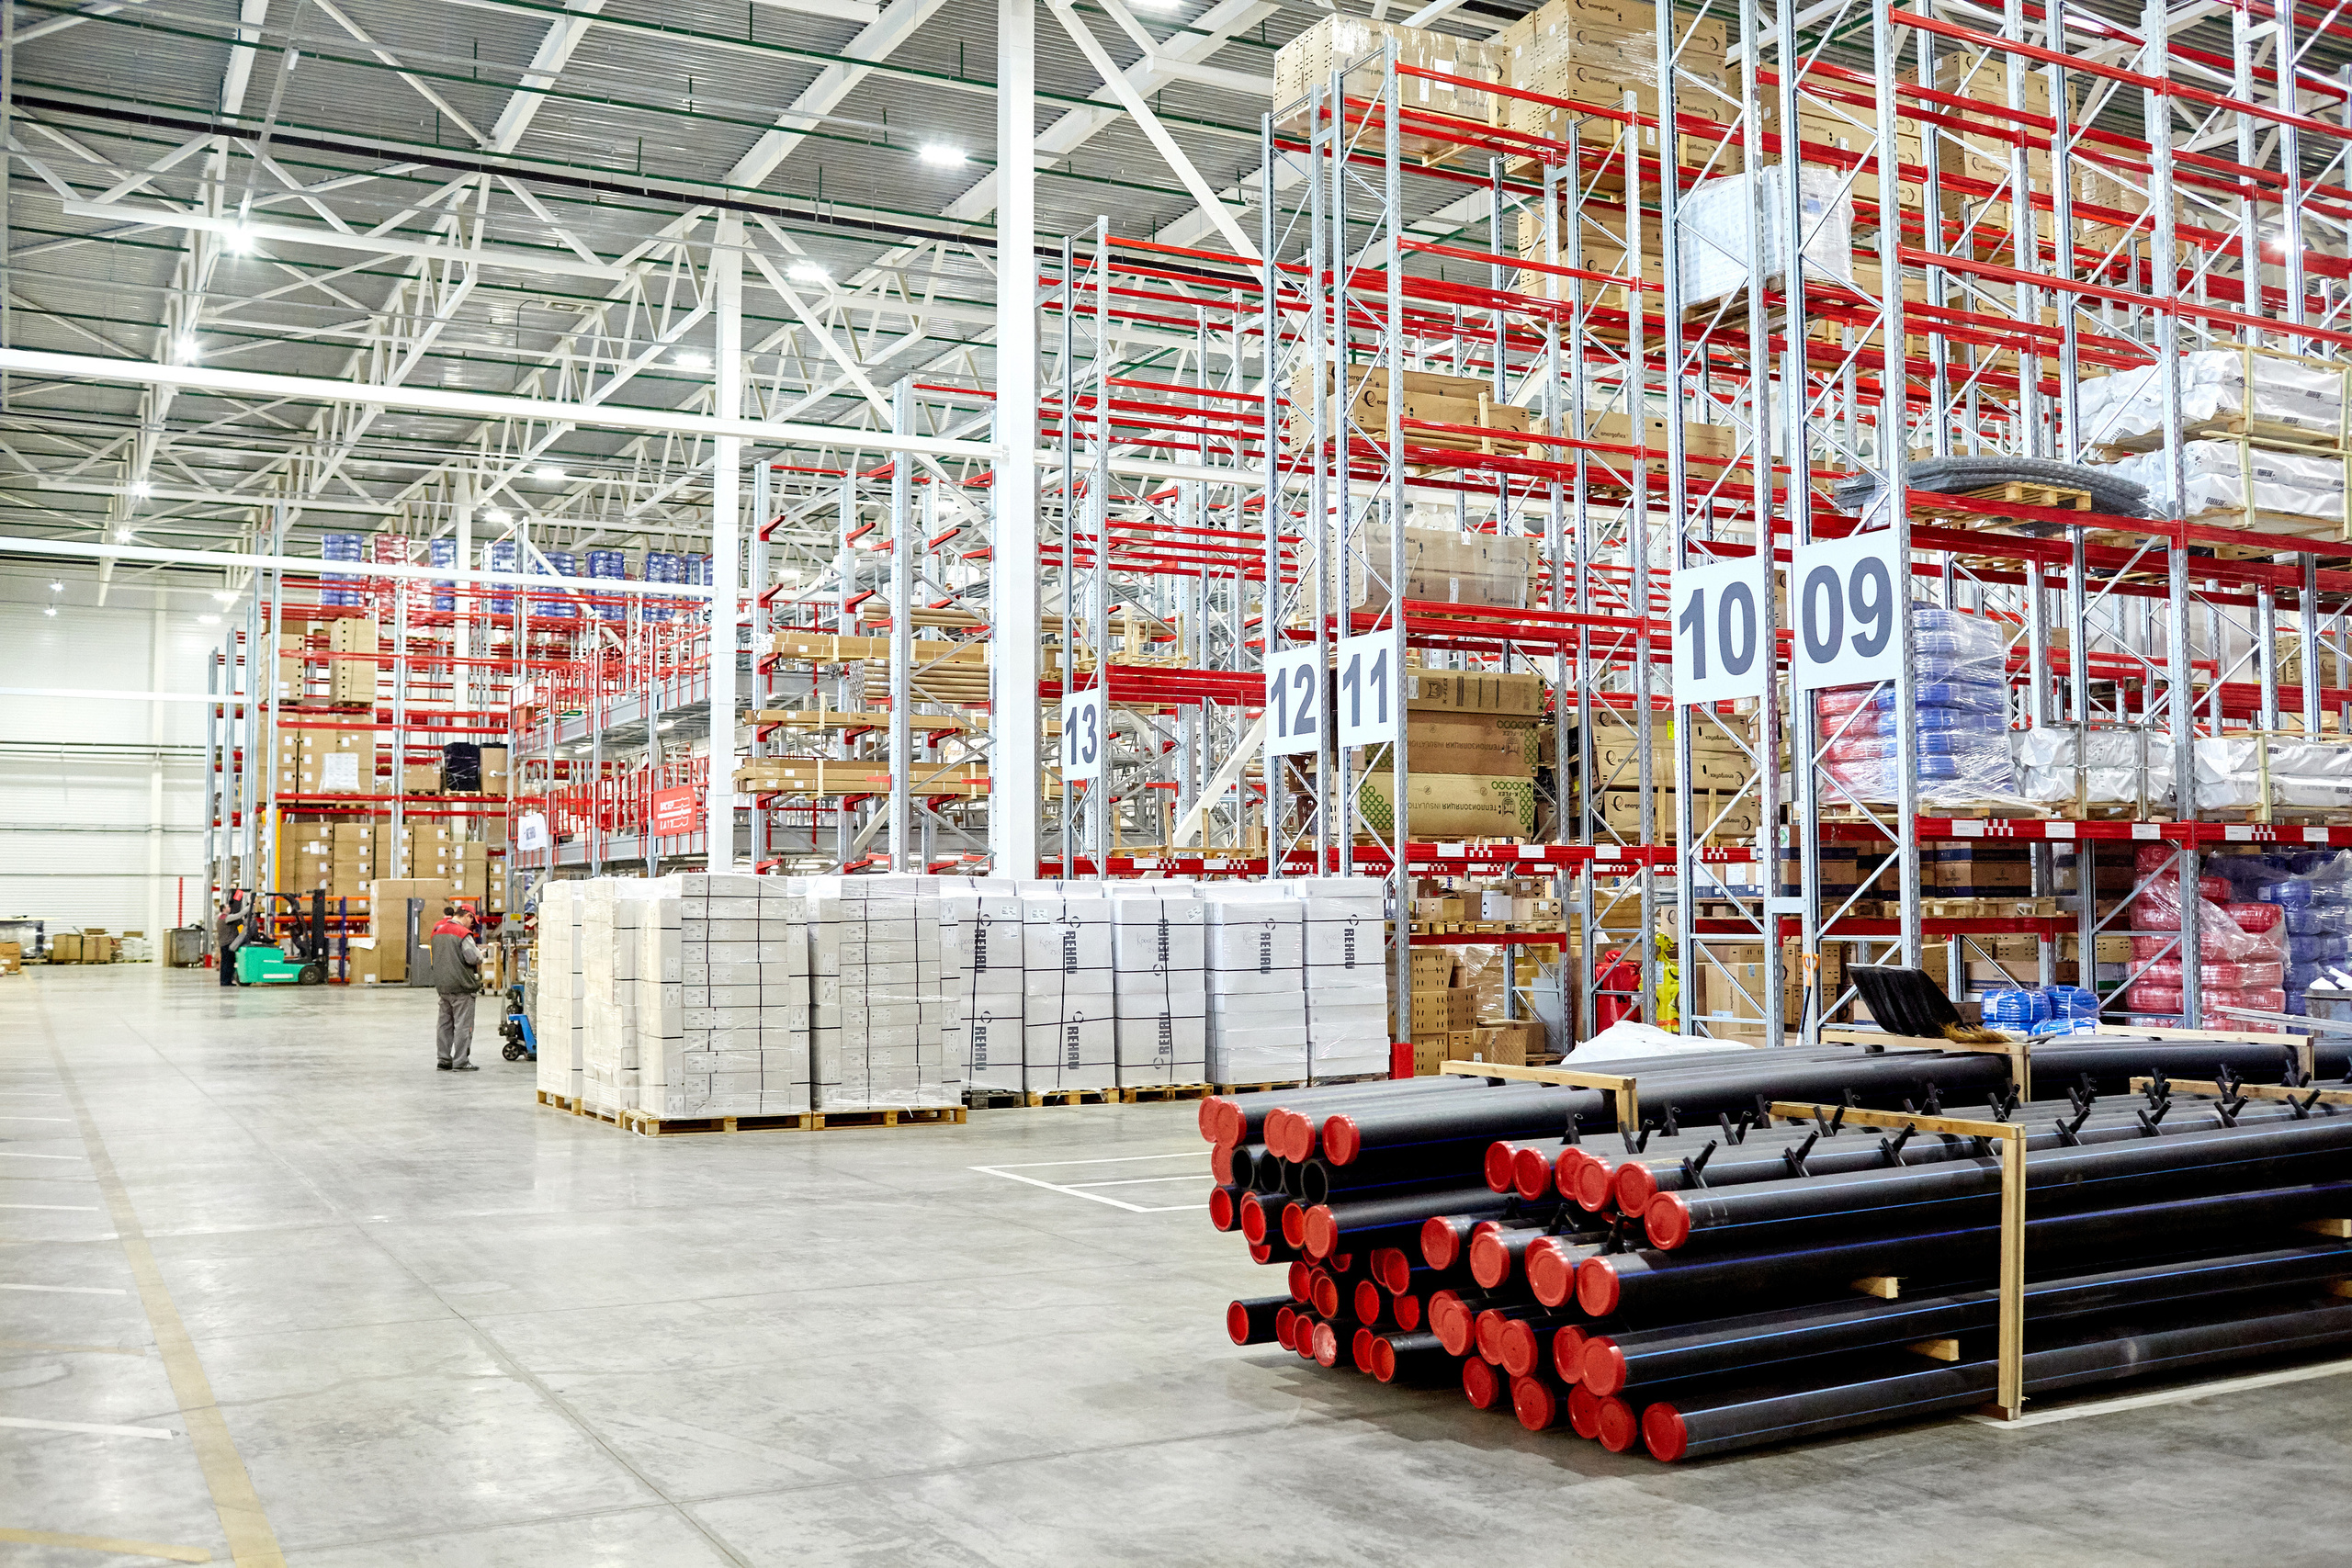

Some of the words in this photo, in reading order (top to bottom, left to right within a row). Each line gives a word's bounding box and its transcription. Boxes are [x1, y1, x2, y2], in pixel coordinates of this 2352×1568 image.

[1600, 431, 1626, 439] energoflex
[2205, 496, 2227, 508] REHAU
[1679, 581, 1757, 681] 10
[1802, 556, 1893, 664] 09
[1271, 663, 1317, 739] 12
[1342, 648, 1387, 728] 11
[1066, 703, 1098, 766] 13
[1408, 802, 1442, 810] INSULATIO
[1442, 803, 1498, 811] ТЕПЛОИЗОЛЯЦИЯ
[975, 929, 987, 974] REHAU
[1065, 931, 1078, 975] REHAU
[1158, 919, 1170, 962] REHAU
[1260, 931, 1272, 975] REHAU
[1344, 928, 1355, 970] REHAU
[975, 1026, 987, 1071] REHAU
[1067, 1026, 1080, 1070] REHAU
[1159, 1011, 1170, 1055] REHAU
